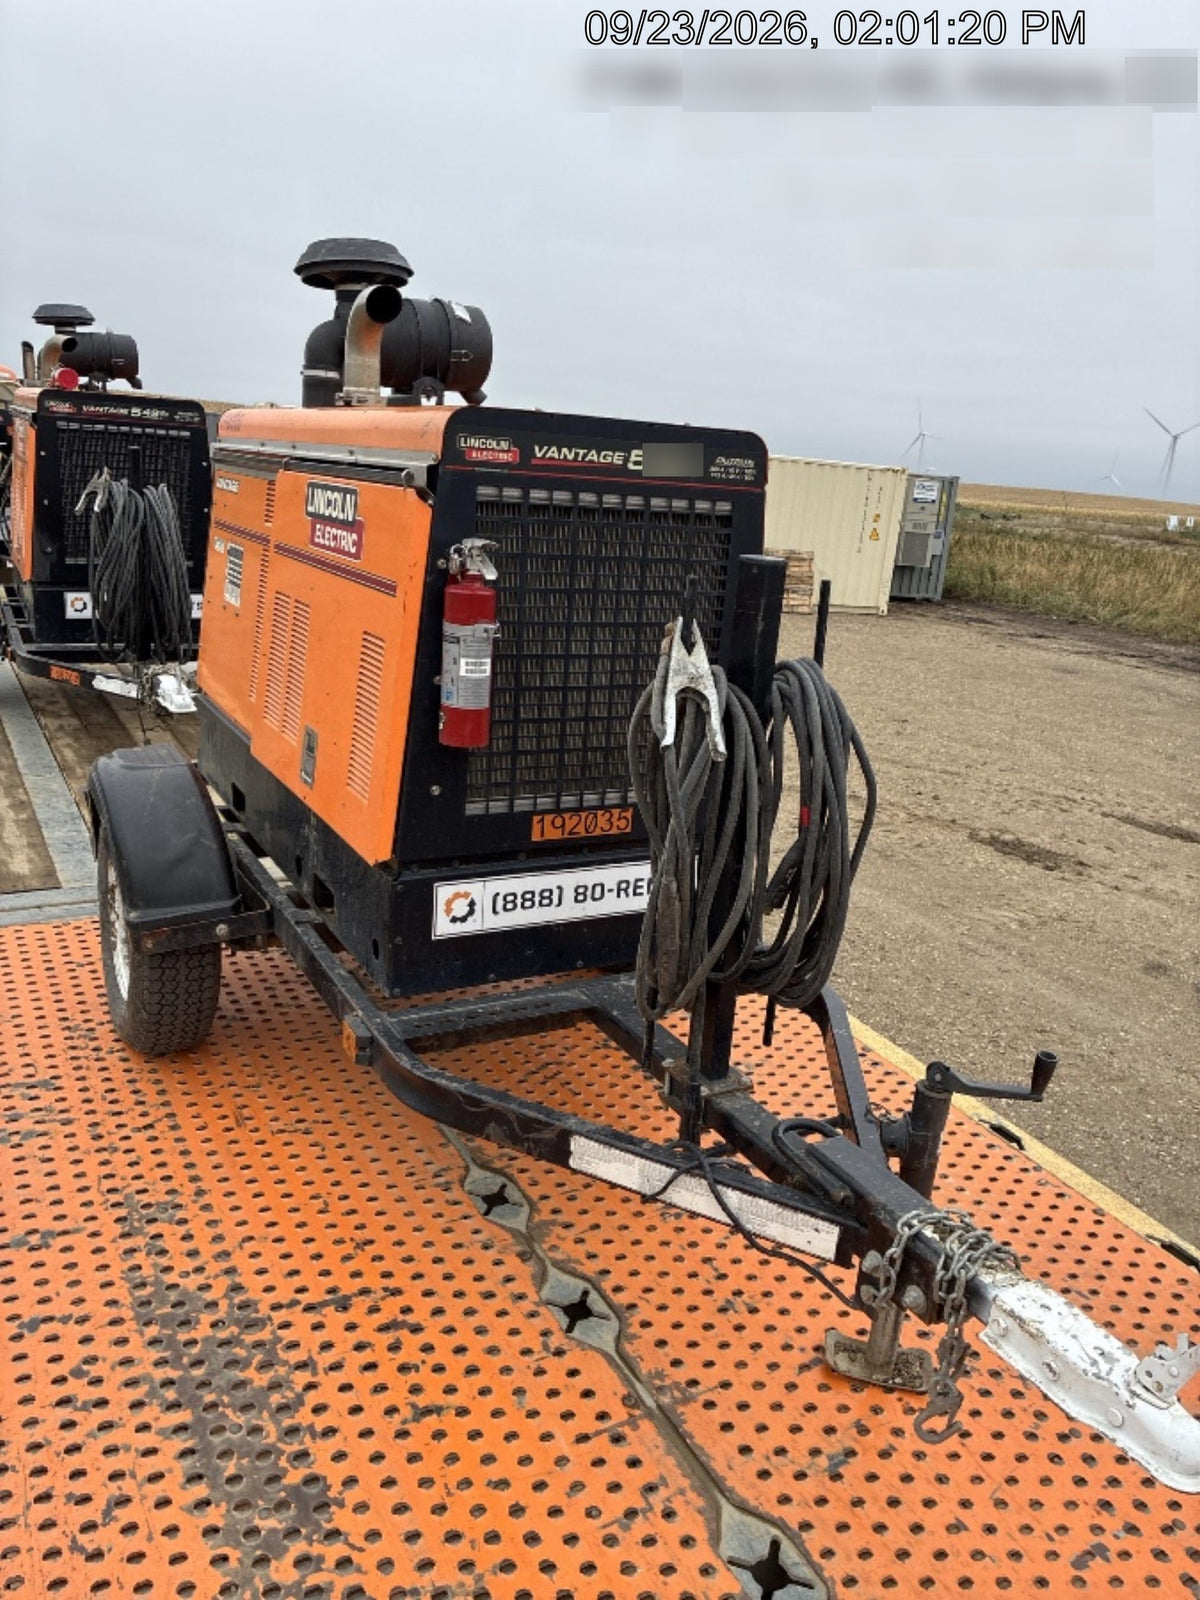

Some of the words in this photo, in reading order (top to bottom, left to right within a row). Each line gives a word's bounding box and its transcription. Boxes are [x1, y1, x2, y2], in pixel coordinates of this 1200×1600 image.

[459, 436, 510, 451] LINCOLN
[471, 450, 514, 461] ELECTRIC
[533, 445, 625, 465] VANTAGE
[307, 486, 356, 522] LINCOLN
[314, 523, 358, 554] ELECTRIC
[536, 809, 631, 838] 192035
[491, 885, 563, 916] (888)
